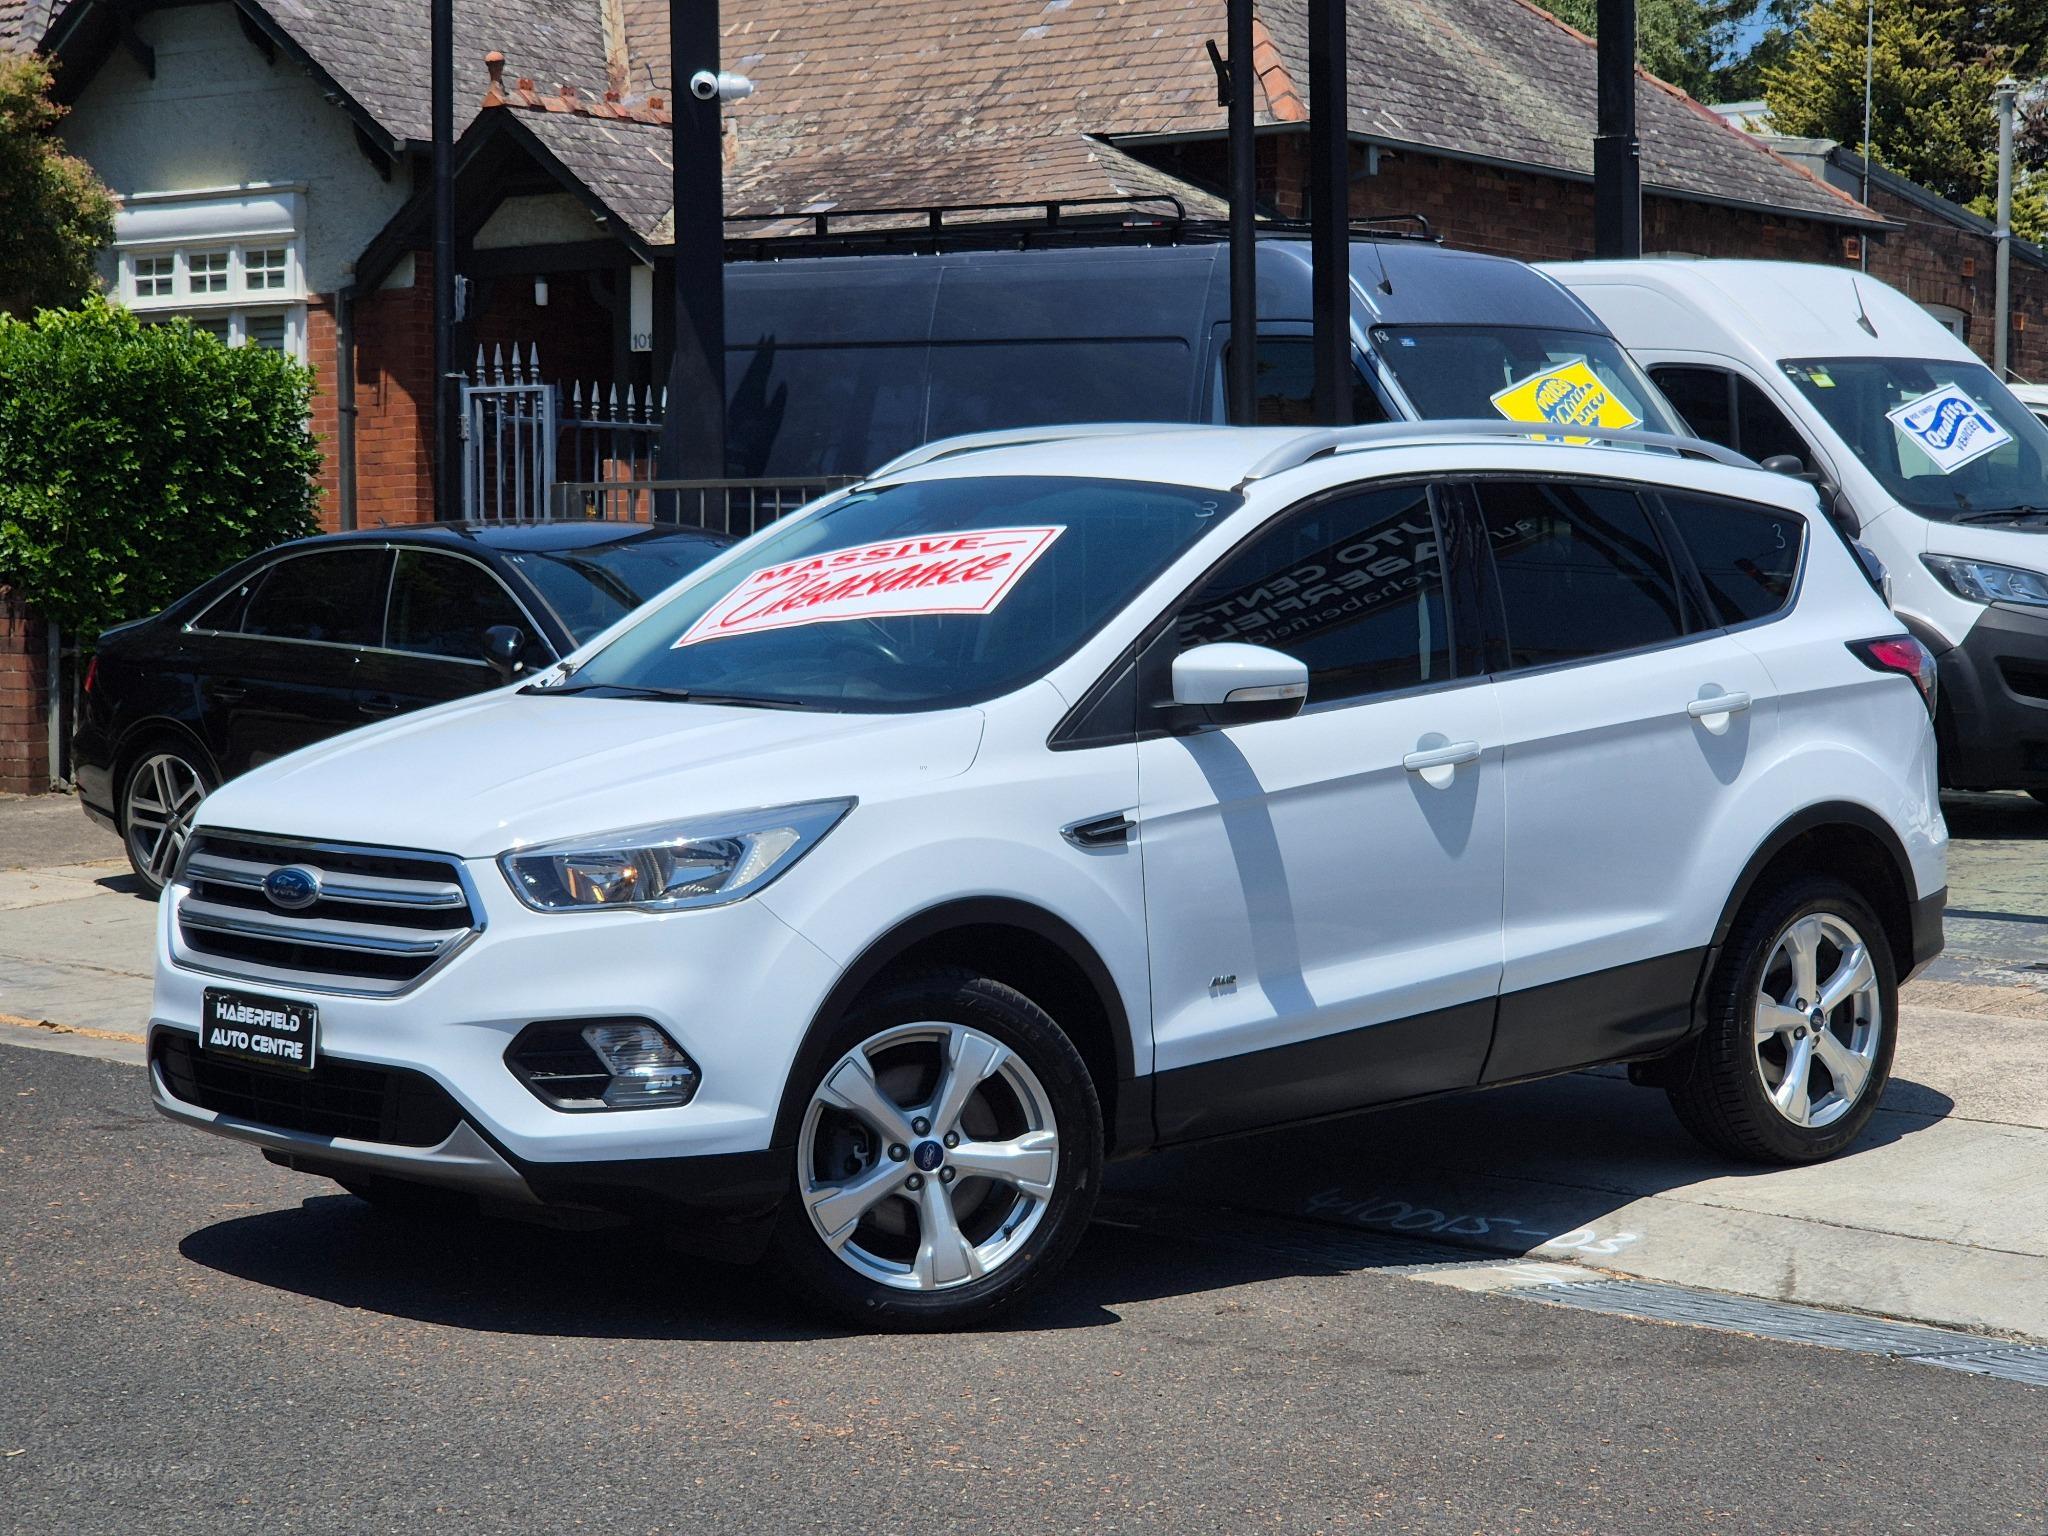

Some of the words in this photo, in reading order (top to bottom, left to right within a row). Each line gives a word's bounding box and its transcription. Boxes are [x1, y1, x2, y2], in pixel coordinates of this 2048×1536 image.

[633, 333, 653, 349] 101
[1925, 400, 1977, 447] Quality
[1772, 523, 1786, 548] 3
[754, 537, 987, 583] MASSIVE
[719, 552, 1012, 628] Clearance
[216, 1002, 300, 1032] HABERFIELD
[210, 1028, 249, 1049] AUTO
[251, 1034, 304, 1059] CENTRE
